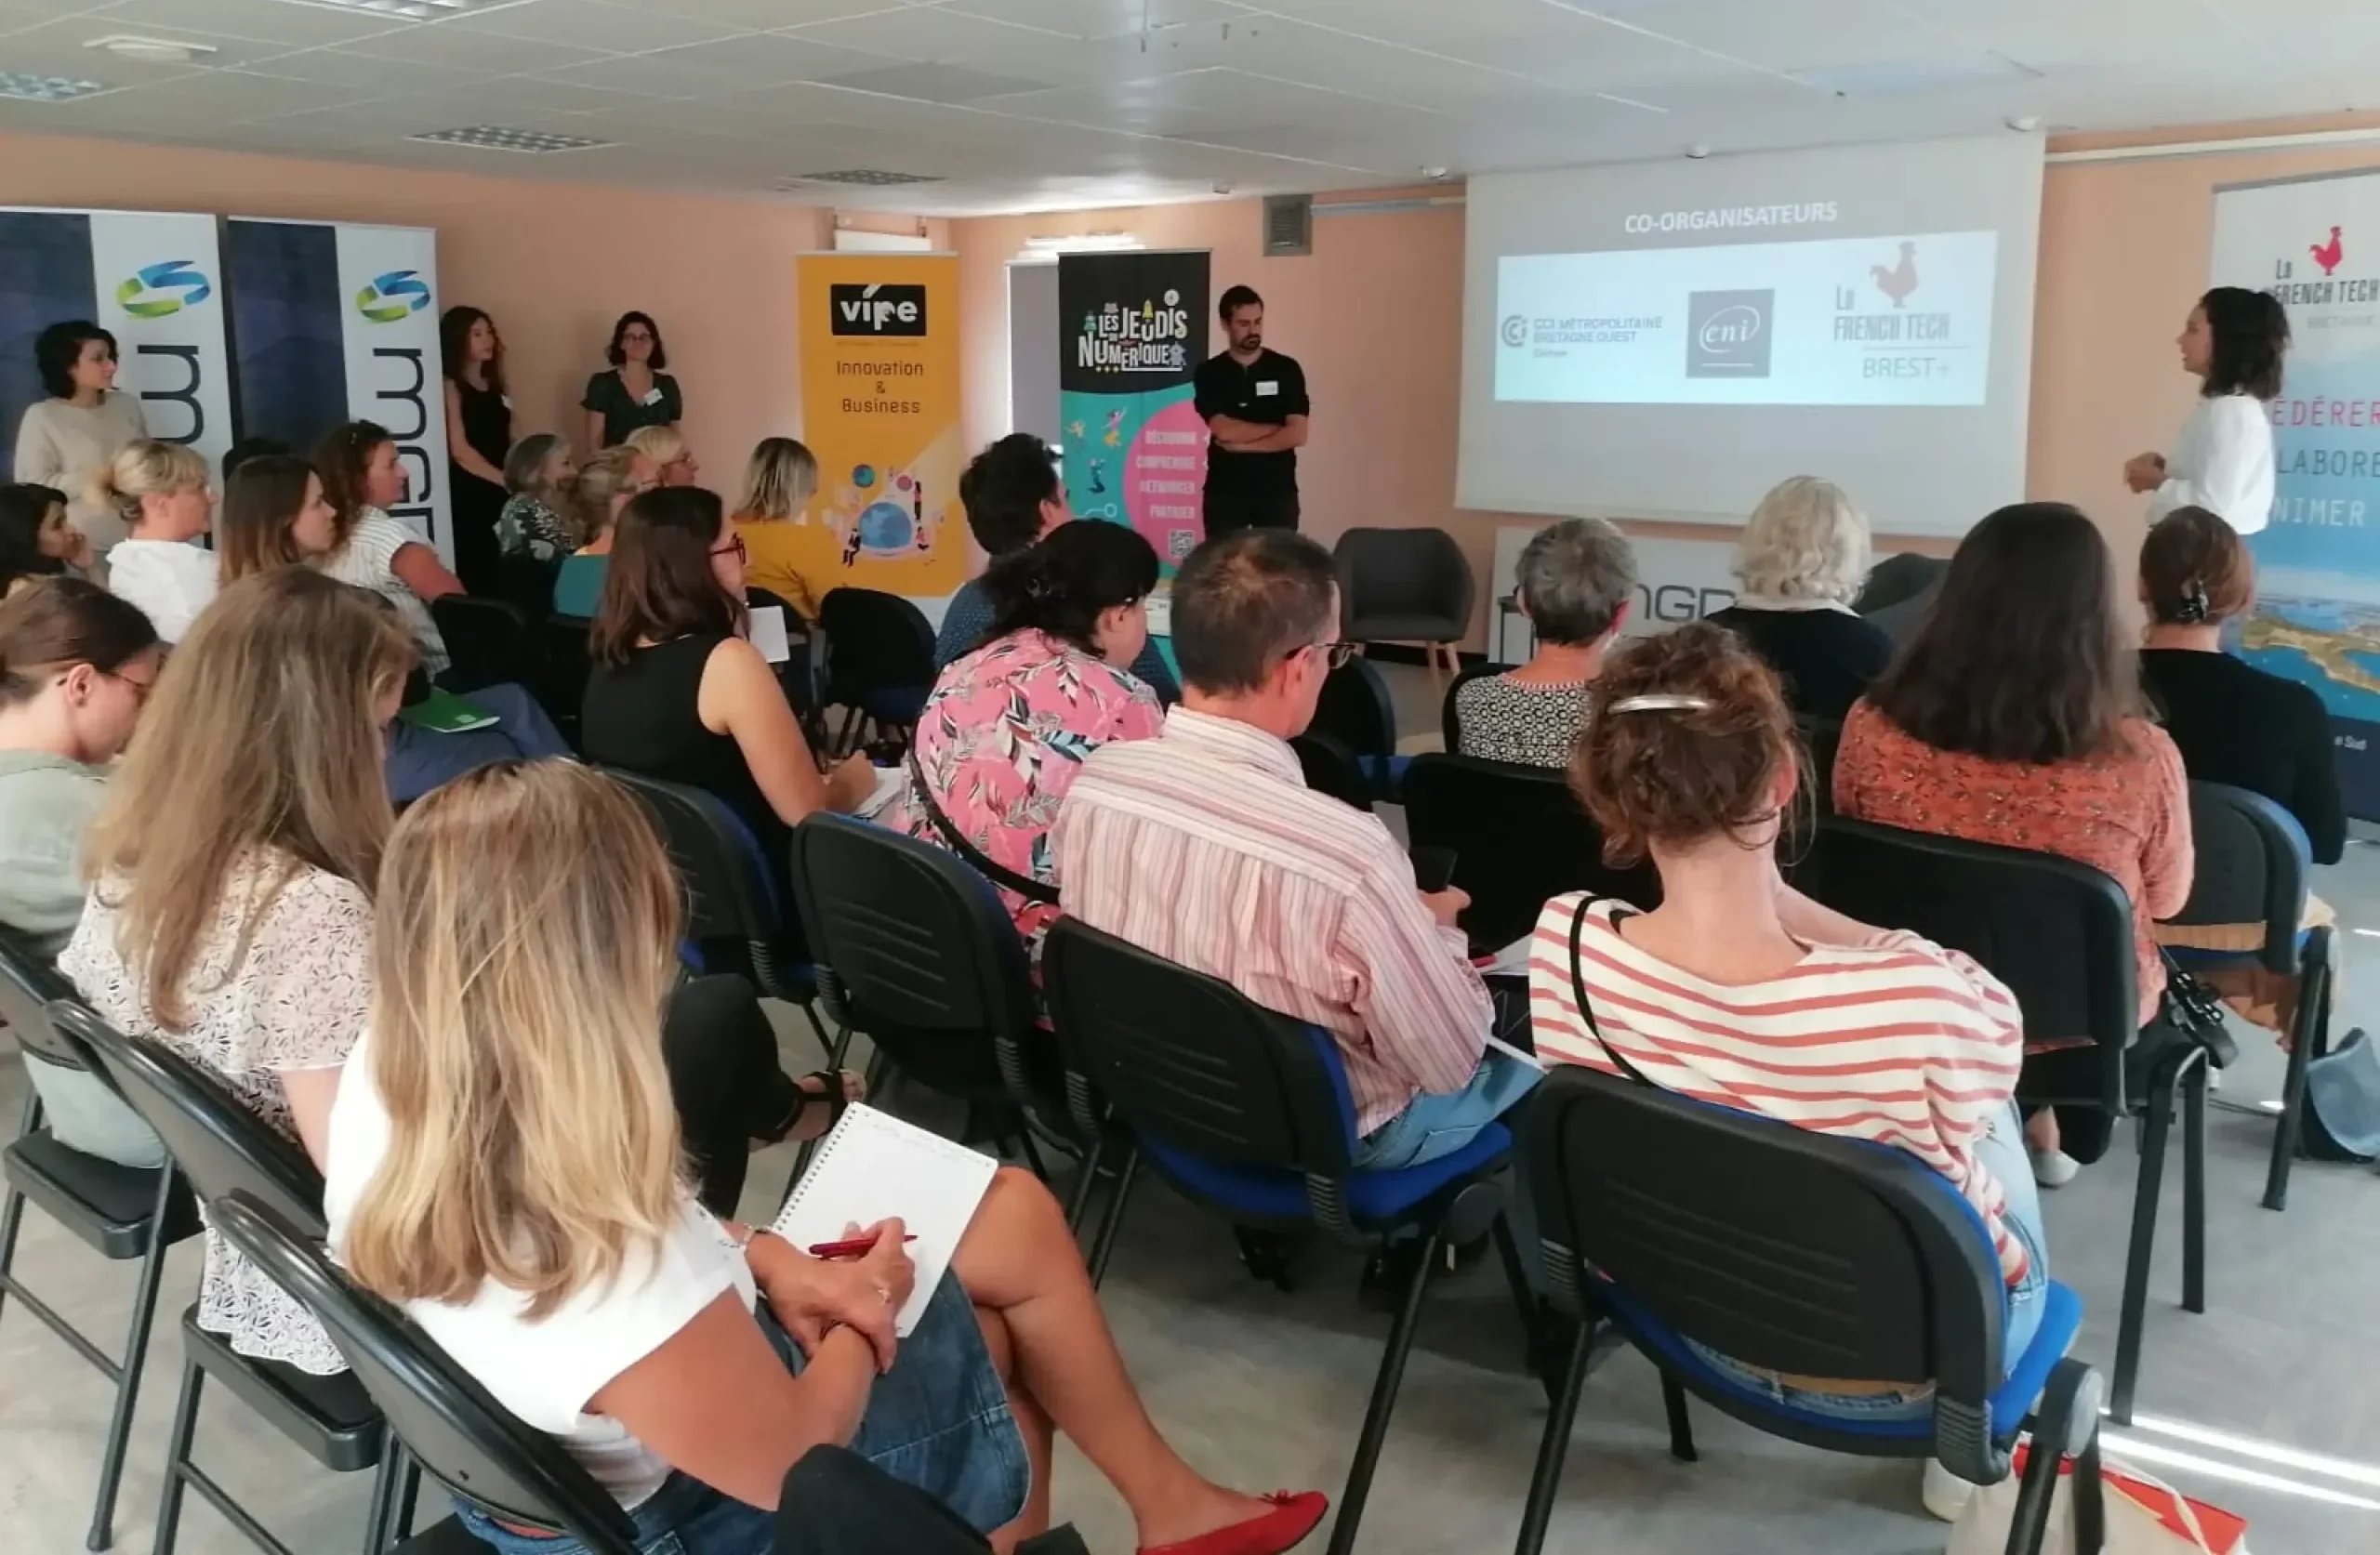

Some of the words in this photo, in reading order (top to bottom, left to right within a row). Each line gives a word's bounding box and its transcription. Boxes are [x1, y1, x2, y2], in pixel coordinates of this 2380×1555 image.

[1624, 201, 1839, 233] CO-ORGANISATEURS
[2339, 279, 2380, 304] TECH
[1098, 314, 1119, 338] LES
[1119, 307, 1189, 342] JEUDIS
[1833, 314, 1900, 342] FRENCH
[1906, 312, 1951, 340] TECH
[837, 360, 924, 376] Innovation
[875, 380, 886, 394] &
[842, 398, 921, 414] Business
[2271, 394, 2380, 428] ÉDÉRER
[2277, 449, 2380, 478] LABORE
[2271, 494, 2367, 527] NIMER
